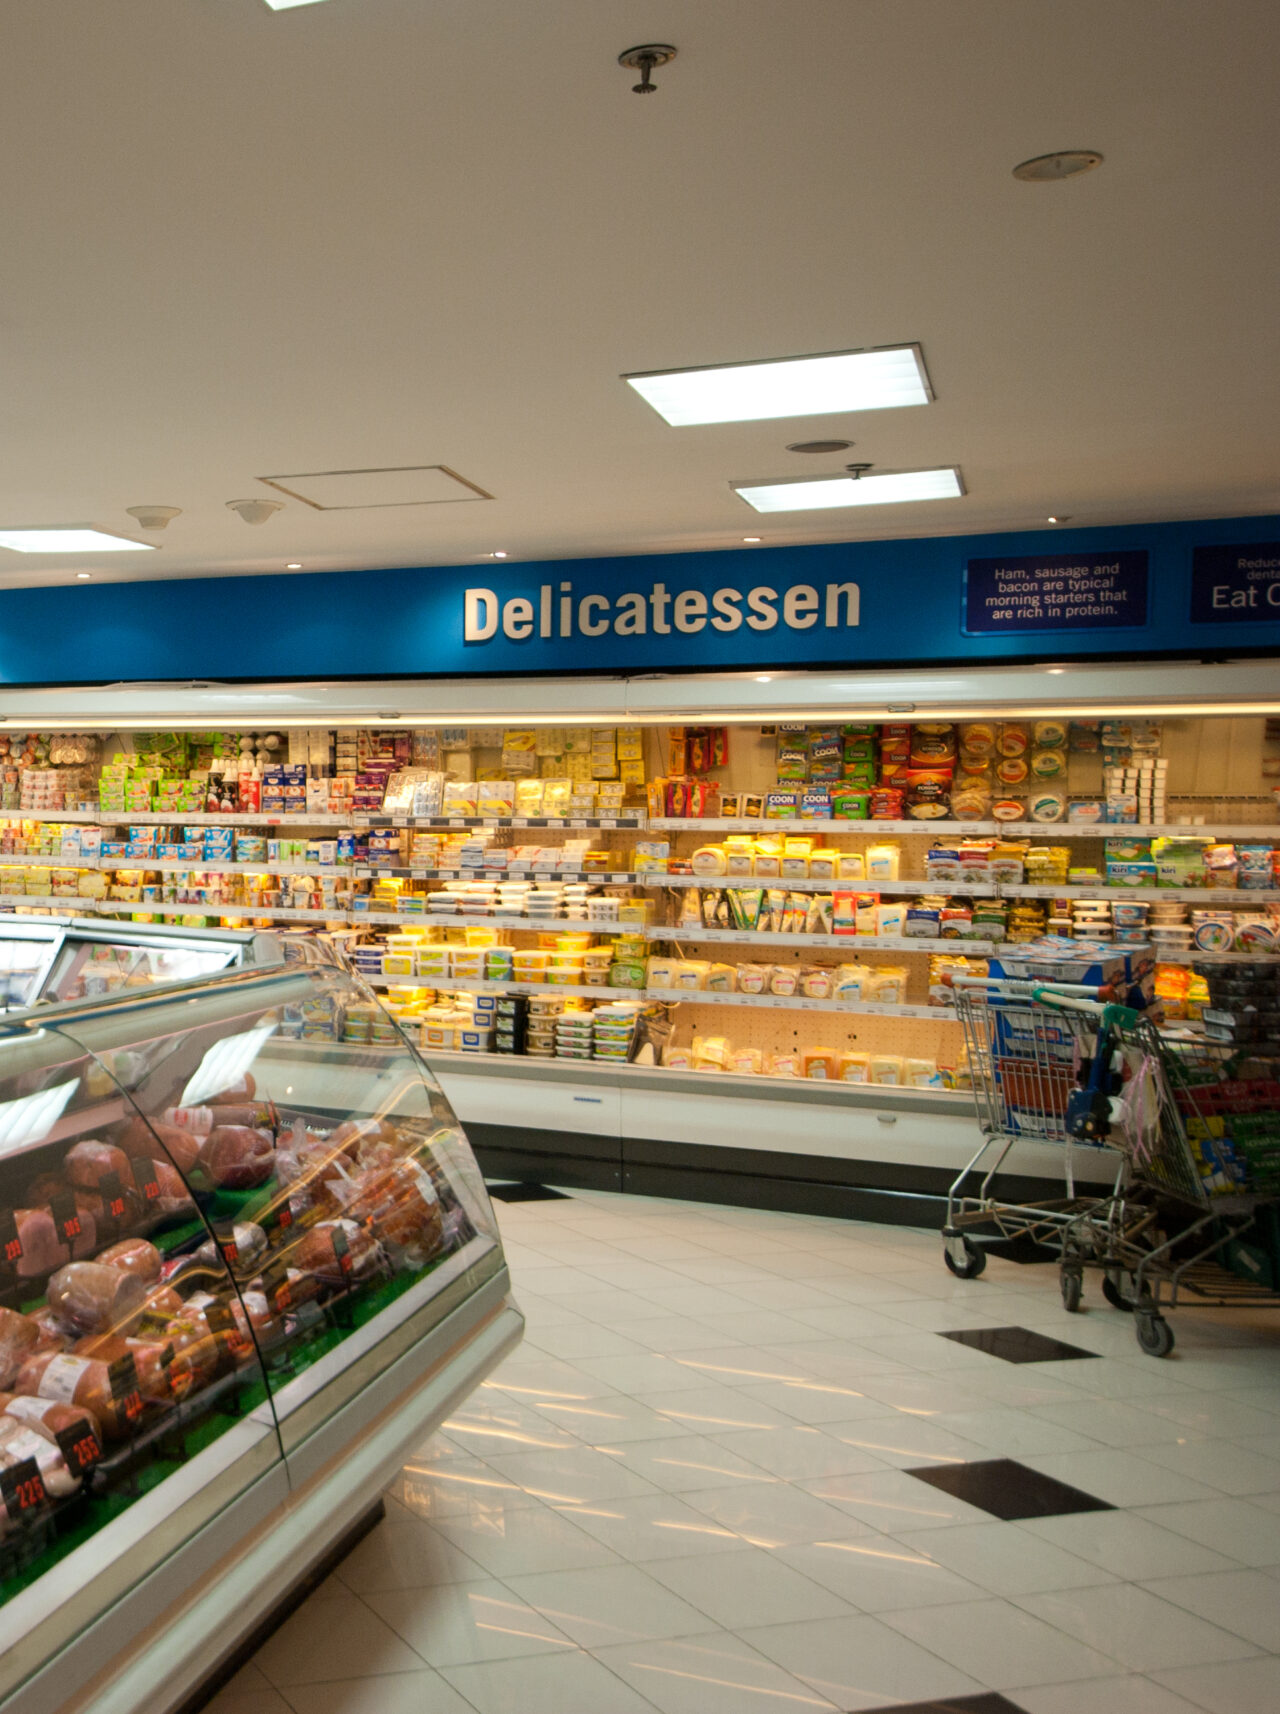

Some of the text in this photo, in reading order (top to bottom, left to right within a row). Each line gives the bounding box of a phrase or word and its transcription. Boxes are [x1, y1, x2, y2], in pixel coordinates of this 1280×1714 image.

[995, 563, 1120, 580] Ham, sausage and
[998, 577, 1114, 593] bacon are typical
[985, 589, 1127, 607] morning starters that
[1212, 585, 1258, 608] Eat
[464, 582, 861, 643] Delicatessen
[992, 603, 1118, 619] are rich in protein.
[769, 795, 794, 804] COON
[803, 794, 829, 803] COON
[1112, 865, 1127, 873] kiri
[1161, 866, 1176, 874] kiri
[73, 1434, 100, 1468] 255
[15, 1475, 45, 1509] 225
